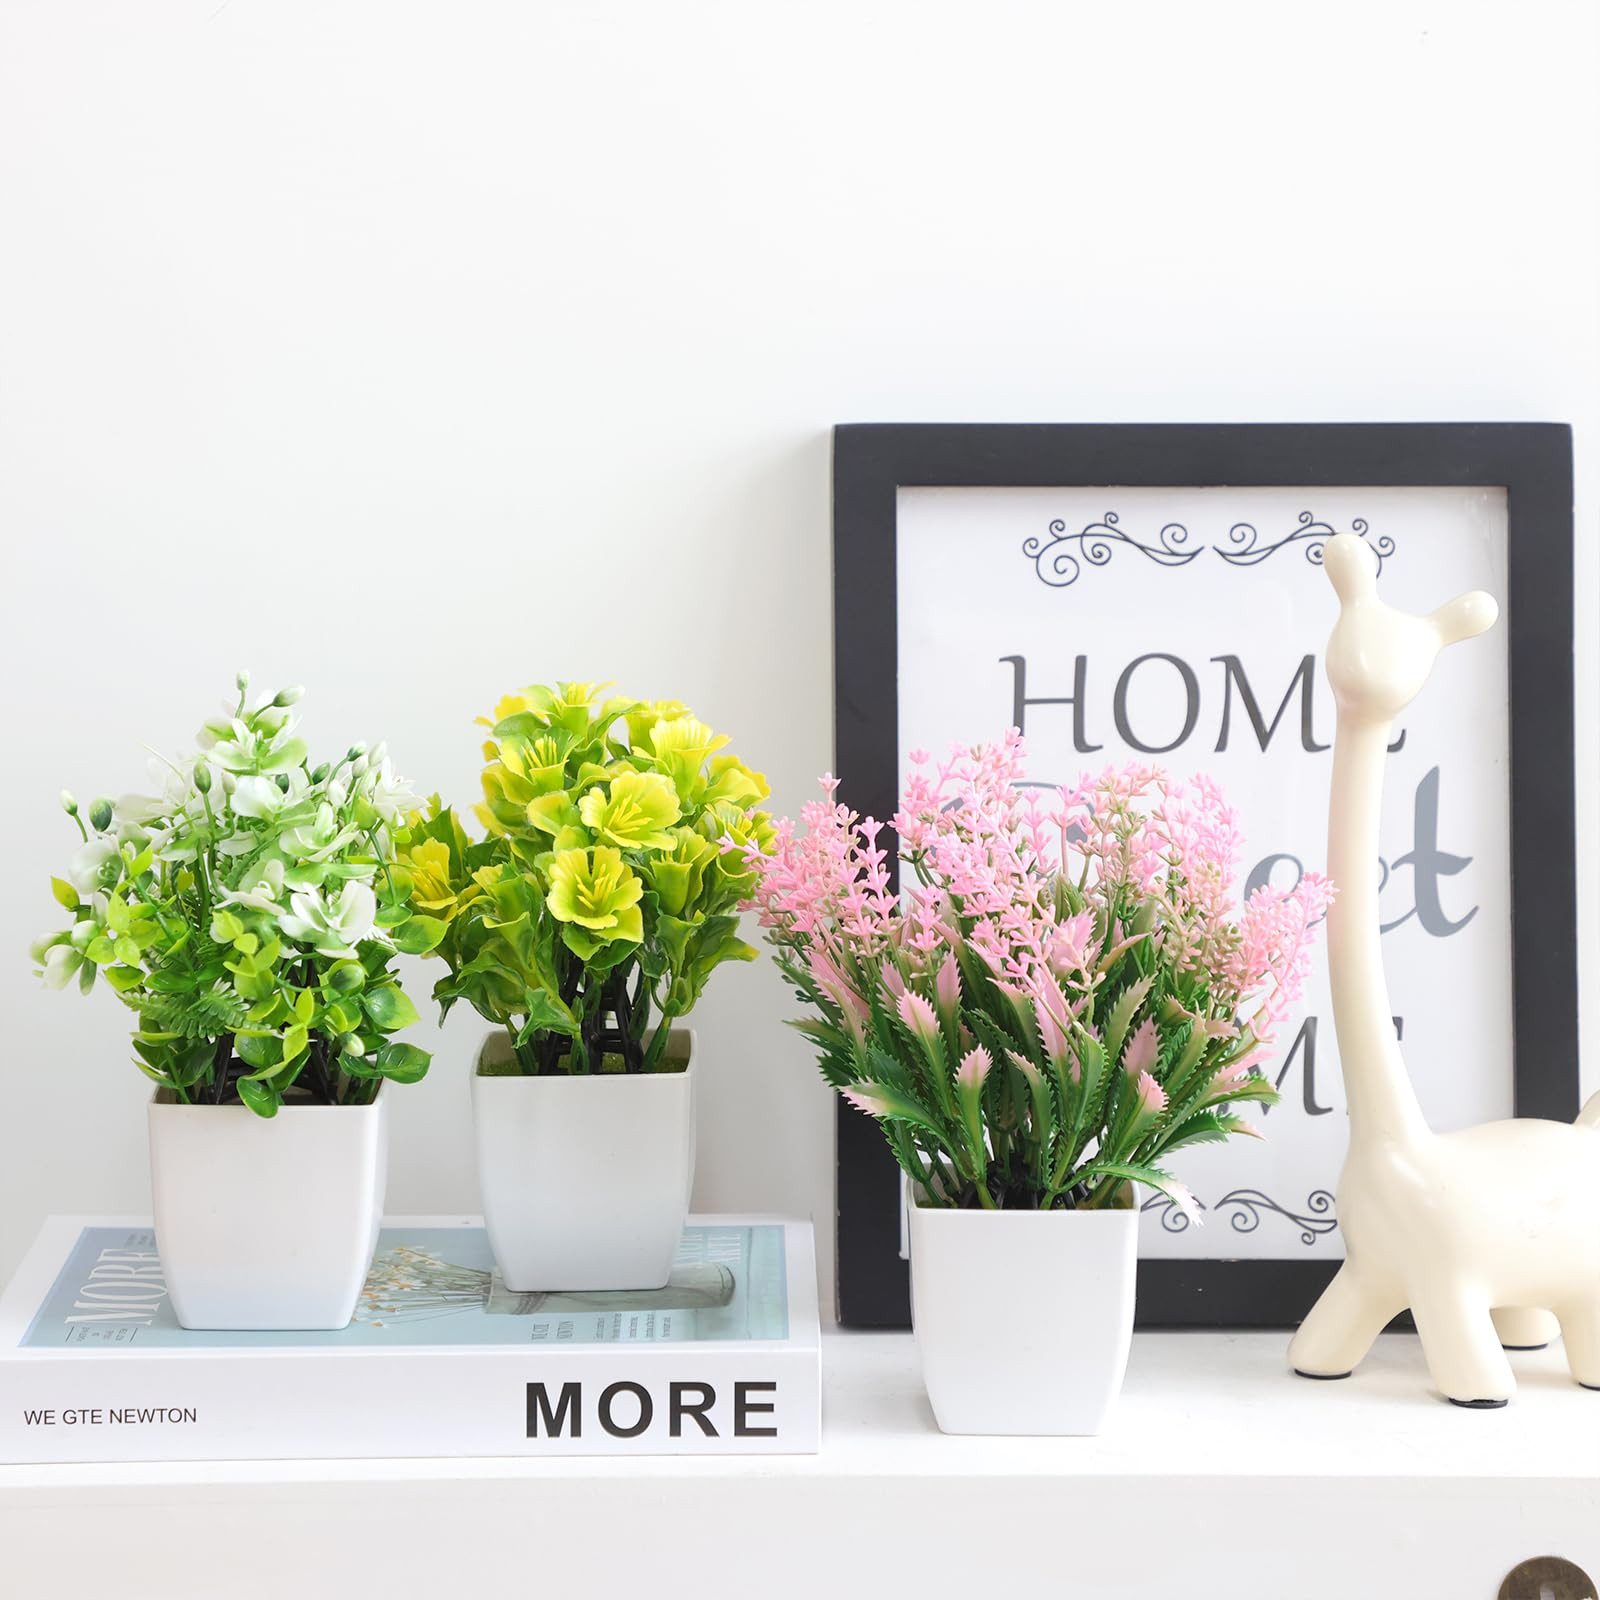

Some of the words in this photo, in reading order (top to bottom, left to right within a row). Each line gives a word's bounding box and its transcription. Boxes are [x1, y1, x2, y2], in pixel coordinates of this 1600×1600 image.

[998, 652, 1406, 754] HOM
[23, 1409, 56, 1425] WE
[62, 1409, 103, 1425] GTE
[109, 1407, 198, 1424] NEWTON
[526, 1380, 778, 1438] MORE
